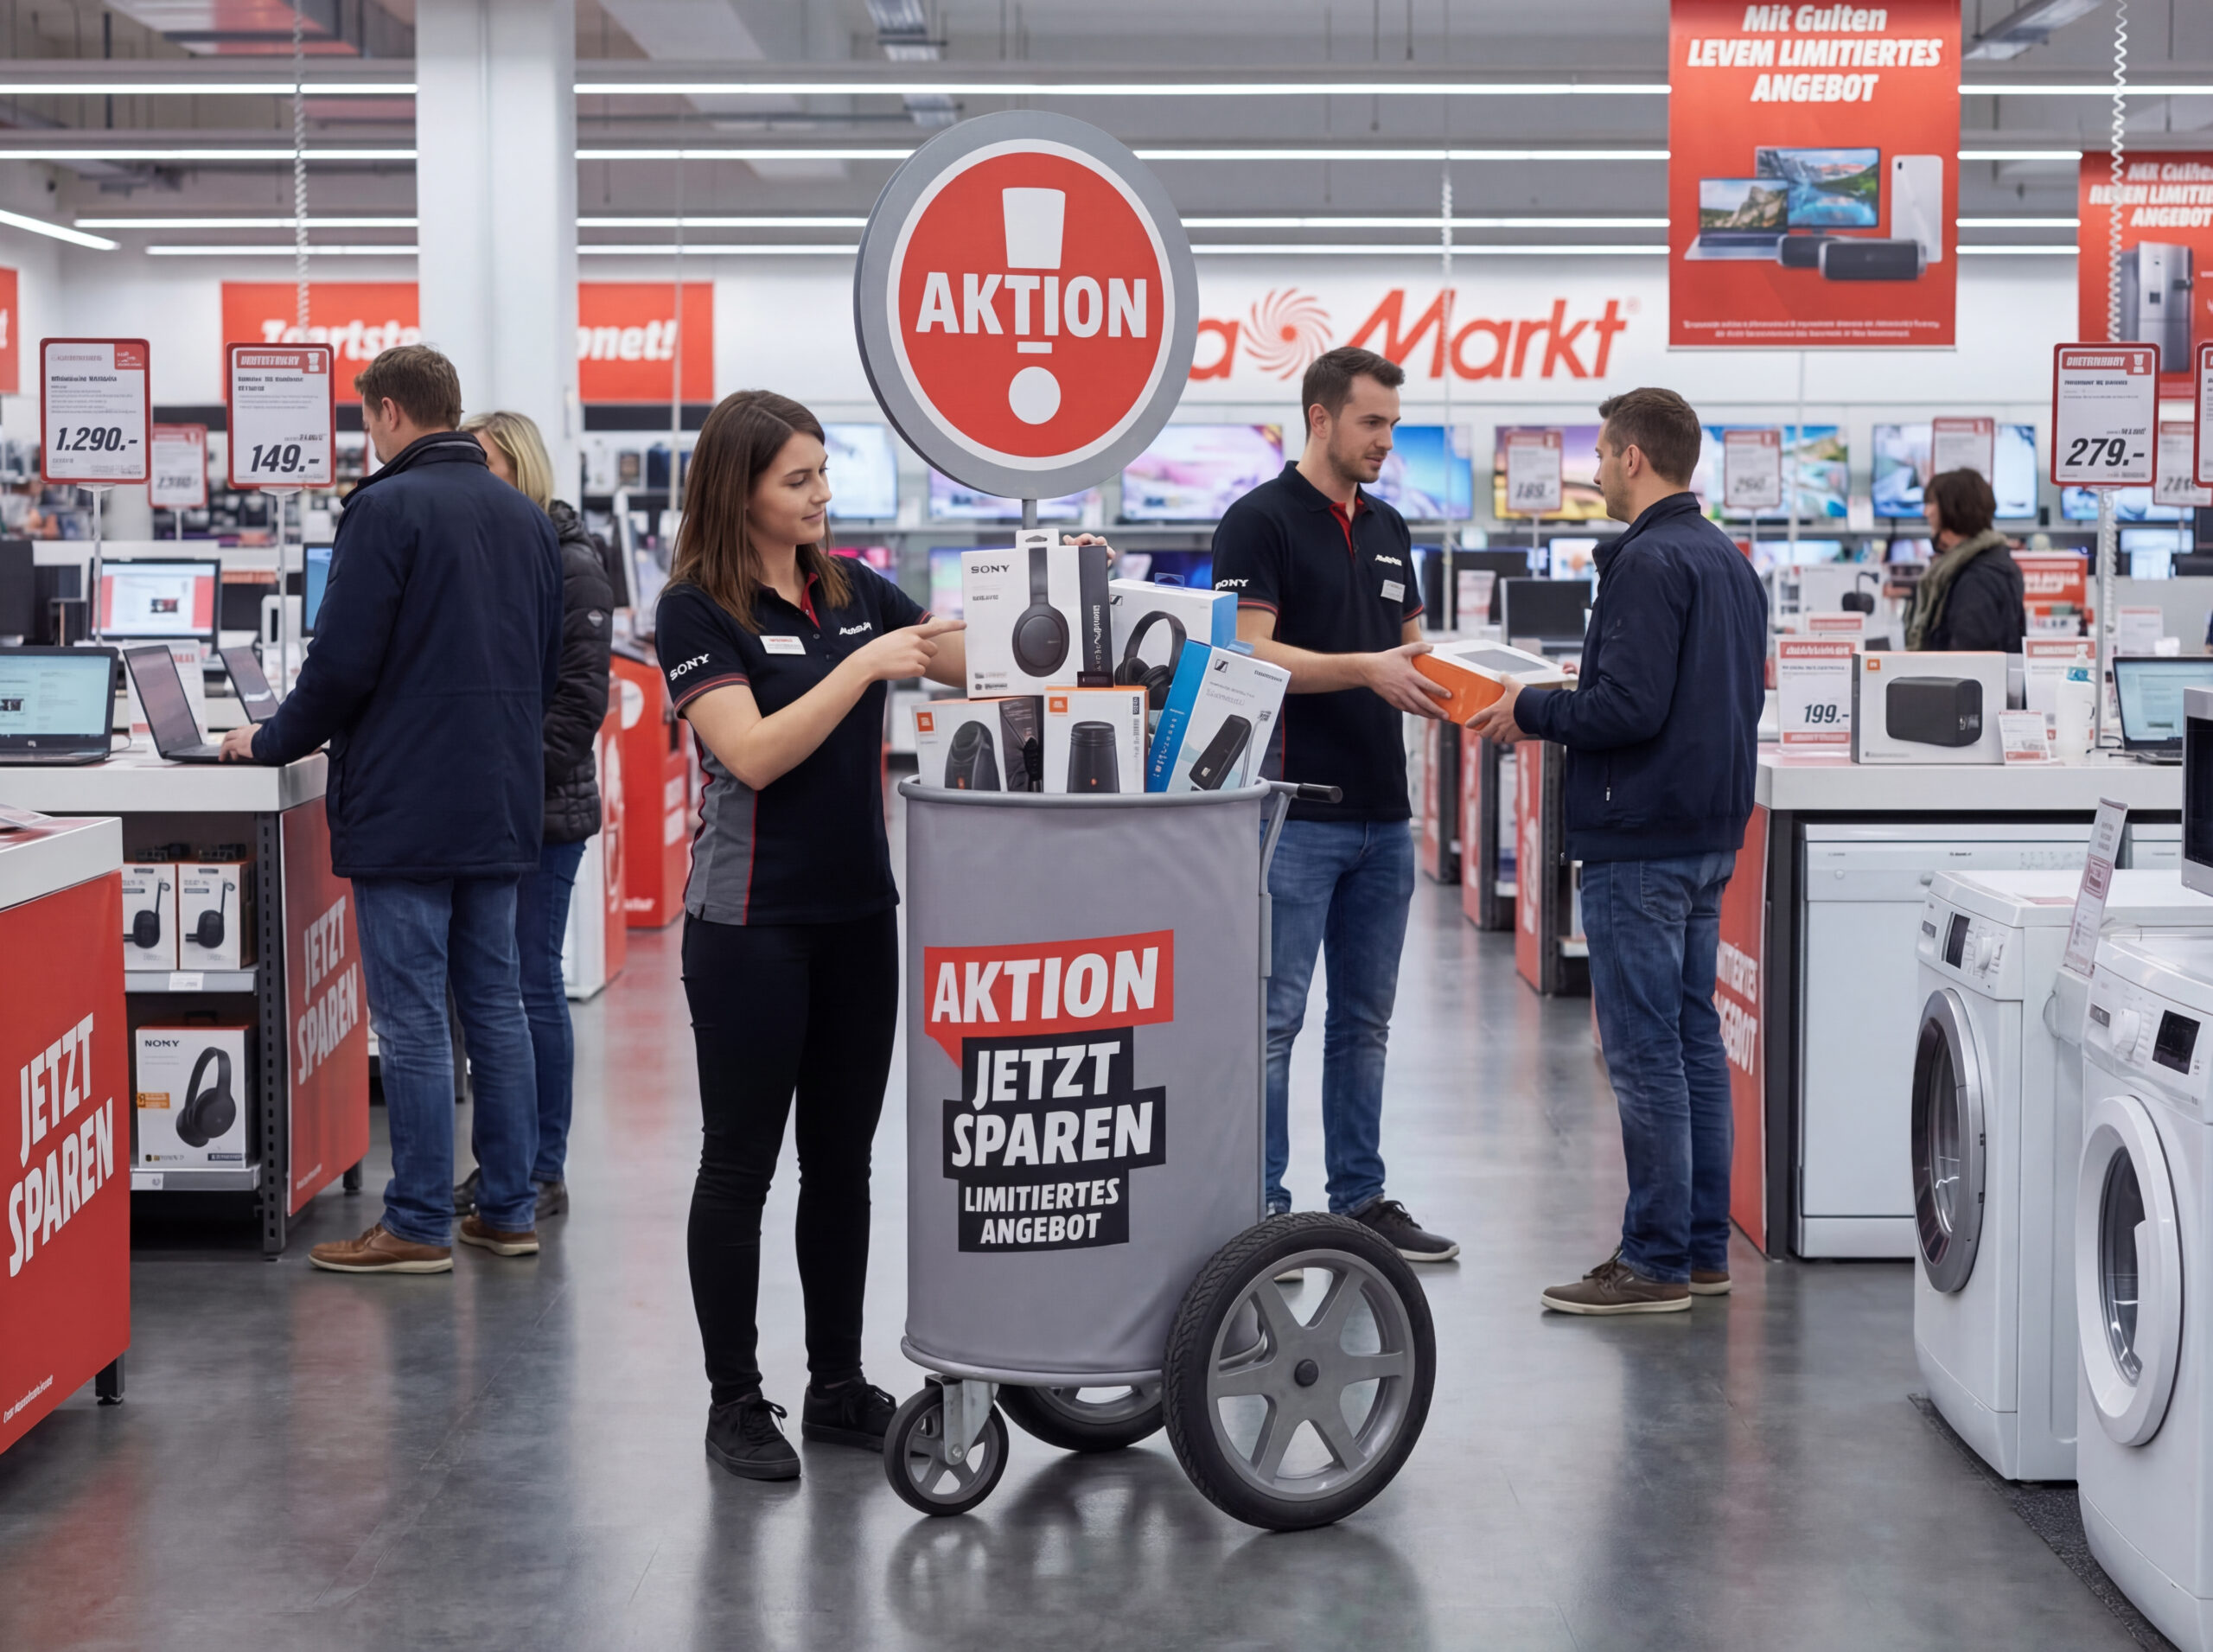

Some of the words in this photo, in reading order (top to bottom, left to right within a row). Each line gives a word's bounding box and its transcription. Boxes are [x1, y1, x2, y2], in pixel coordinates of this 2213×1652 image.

[1742, 4, 1791, 32] Mit
[1687, 39, 1775, 67] LEVEM
[1778, 39, 1943, 67] LIMITIERTES
[1750, 74, 1879, 102] ANGEBOT
[915, 271, 1147, 338] AKTION
[1345, 288, 1628, 381] Markt
[56, 426, 137, 451] 1.290.-
[2064, 437, 2145, 466] 279.-
[251, 443, 320, 473] 149.-
[971, 564, 1010, 574] SONY
[669, 653, 709, 681] SONY
[1804, 704, 1849, 724] 199.-
[304, 895, 346, 1005] JETZT
[931, 947, 1158, 1024] AKTION
[297, 962, 358, 1086] SPAREN
[20, 1011, 93, 1168] JETZT
[972, 1041, 1120, 1111] JETZT
[952, 1101, 1153, 1167] SPAREN
[9, 1096, 114, 1277] SPAREN
[965, 1177, 1119, 1212] LIMITIERTES
[979, 1212, 1101, 1245] ANGEBOT
